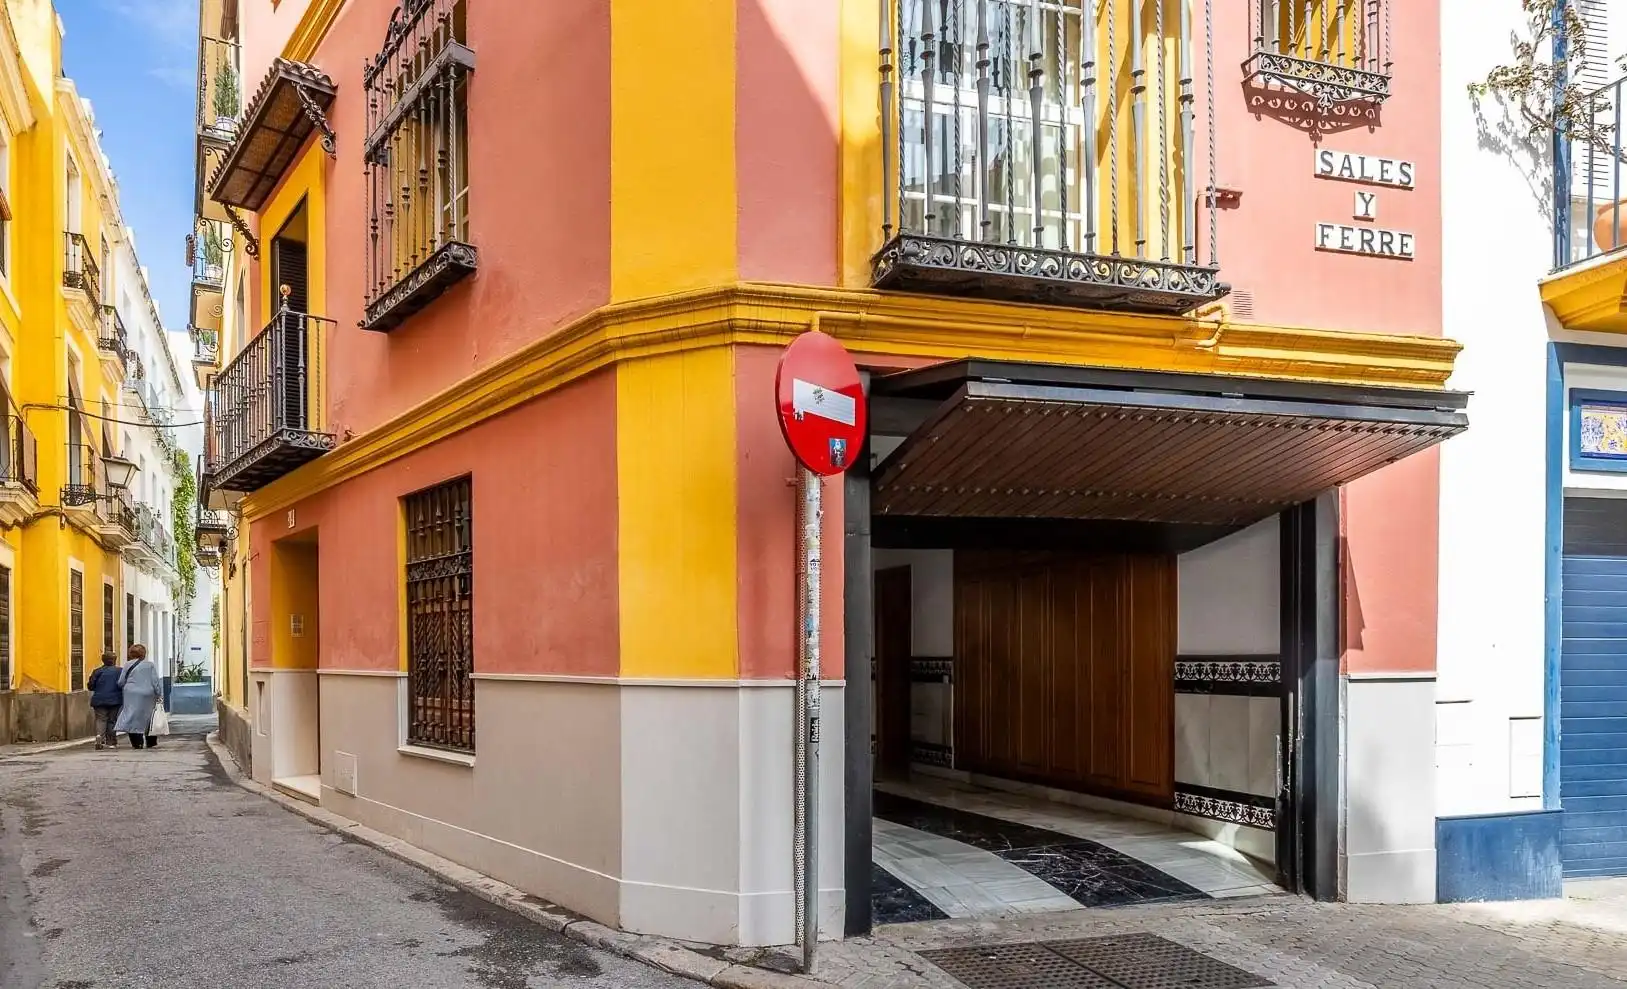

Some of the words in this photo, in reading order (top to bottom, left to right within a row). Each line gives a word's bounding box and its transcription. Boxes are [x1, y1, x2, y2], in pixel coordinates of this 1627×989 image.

[1320, 150, 1412, 186] SALES
[1358, 192, 1375, 216] Y
[1318, 223, 1413, 257] FERRE
